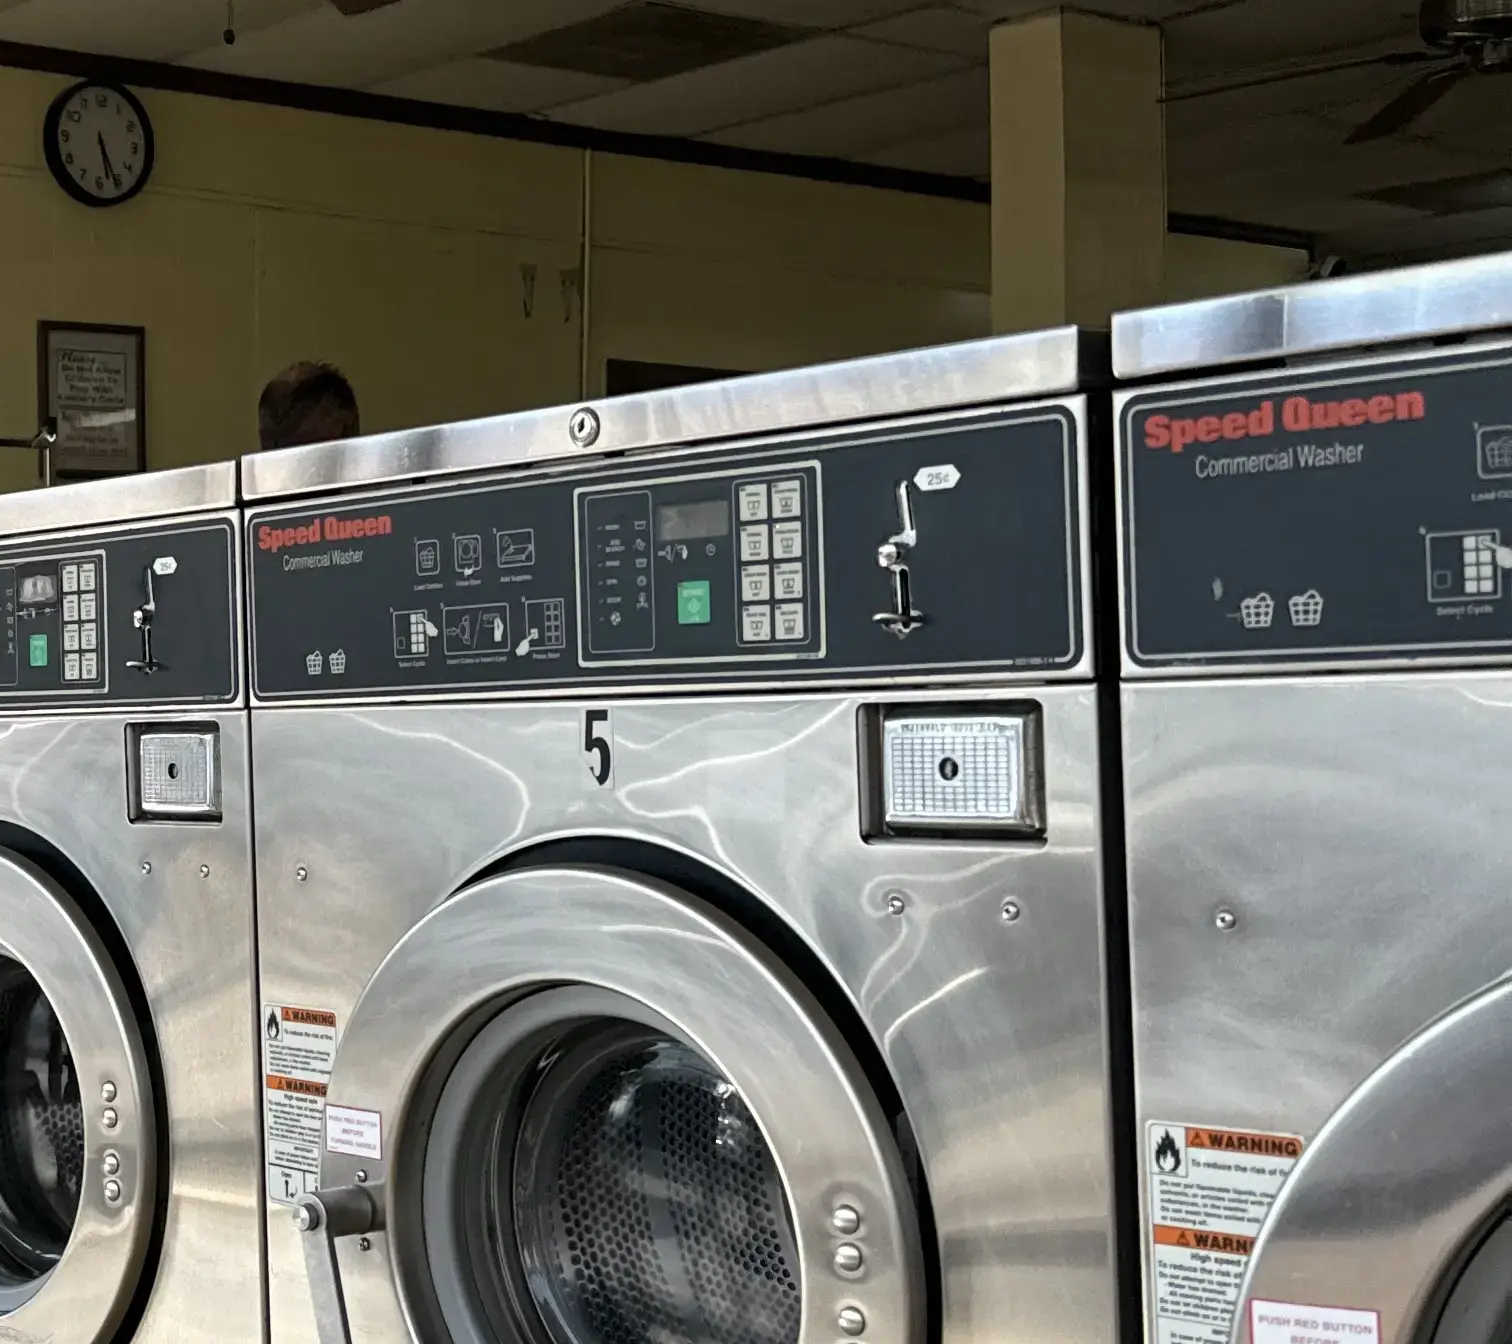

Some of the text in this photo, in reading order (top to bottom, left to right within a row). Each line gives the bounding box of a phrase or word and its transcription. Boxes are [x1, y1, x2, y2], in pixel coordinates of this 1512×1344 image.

[1144, 390, 1426, 453] Speed Queen
[1195, 442, 1366, 479] Commercial Washer
[927, 471, 950, 486] 25¢
[258, 514, 393, 553] Speed Queen
[282, 548, 364, 572] Commercial Washer
[583, 709, 611, 787] 5
[291, 1011, 333, 1025] WARNING
[283, 1093, 294, 1101] High
[284, 1079, 327, 1096] WARNING
[1207, 1133, 1299, 1157] WARNING
[1191, 1159, 1201, 1168] To
[1203, 1161, 1232, 1171] reduce
[1234, 1163, 1248, 1173] the
[1249, 1165, 1266, 1175] risk
[1268, 1167, 1277, 1176] of
[1194, 1233, 1254, 1253] WARN
[1158, 1260, 1167, 1268] To
[1169, 1263, 1198, 1273] reduce
[1200, 1267, 1213, 1275] the
[1215, 1269, 1231, 1277] risk
[1190, 1252, 1241, 1267] High speed
[1258, 1315, 1373, 1335] PUSH RED BUTTON
